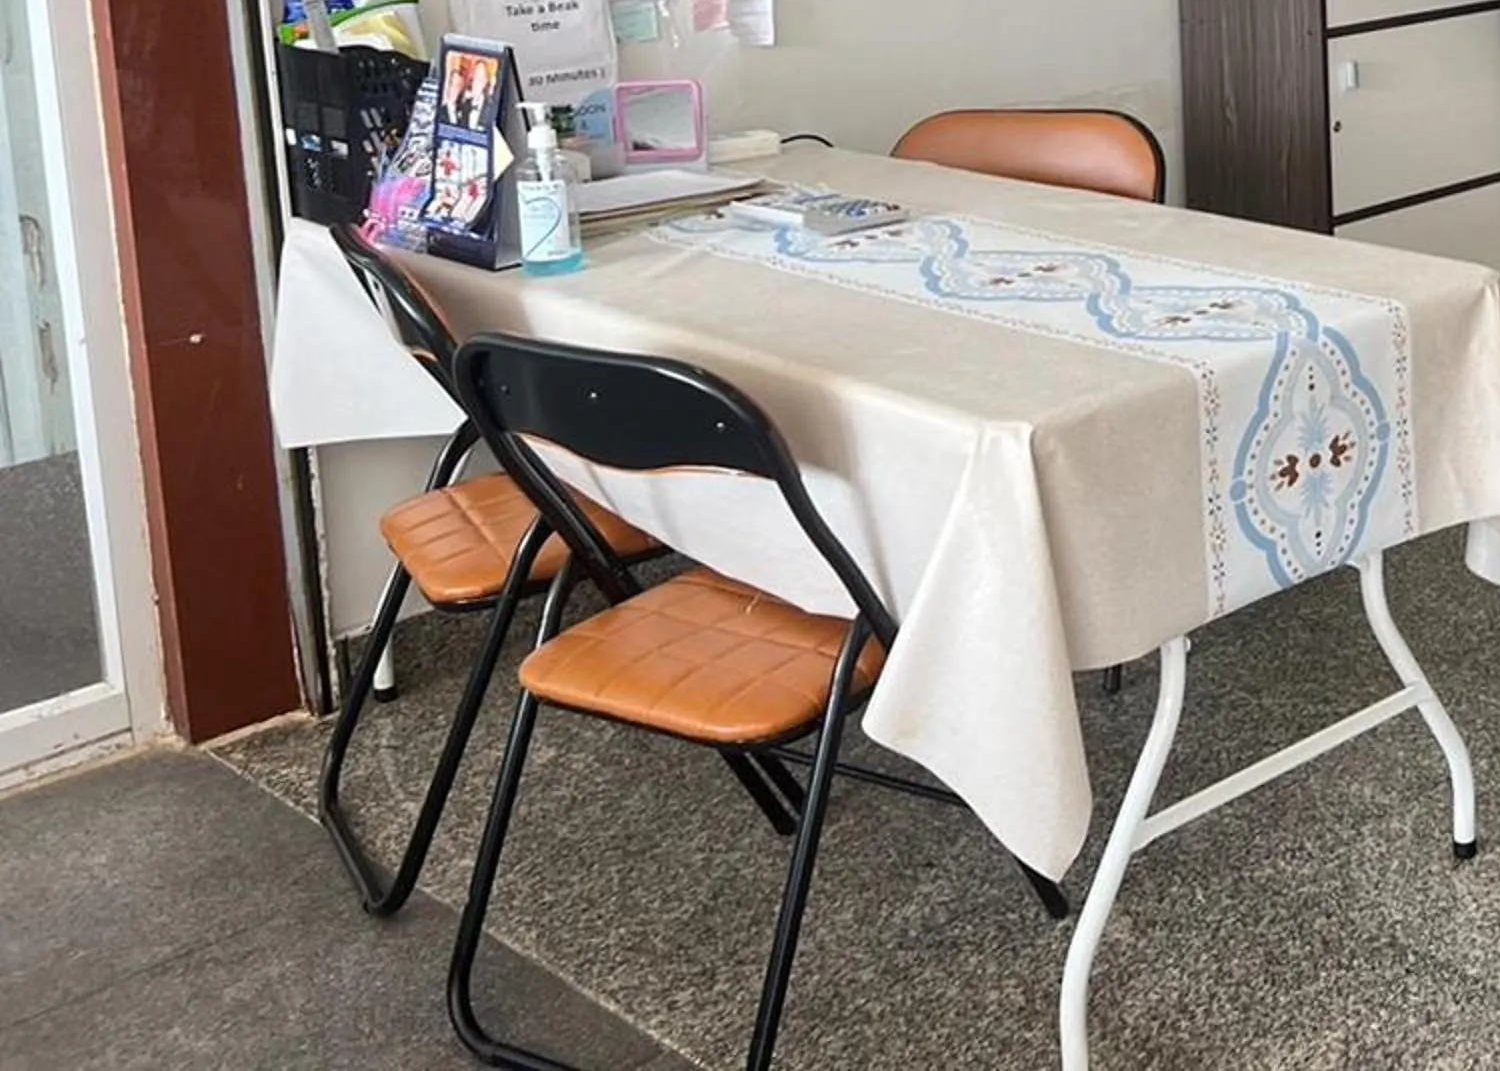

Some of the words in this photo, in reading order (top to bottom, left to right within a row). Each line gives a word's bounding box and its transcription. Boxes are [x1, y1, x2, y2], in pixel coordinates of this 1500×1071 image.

[505, 2, 533, 17] Take
[538, 4, 546, 14] a
[548, 0, 579, 13] Beak
[531, 21, 560, 31] time
